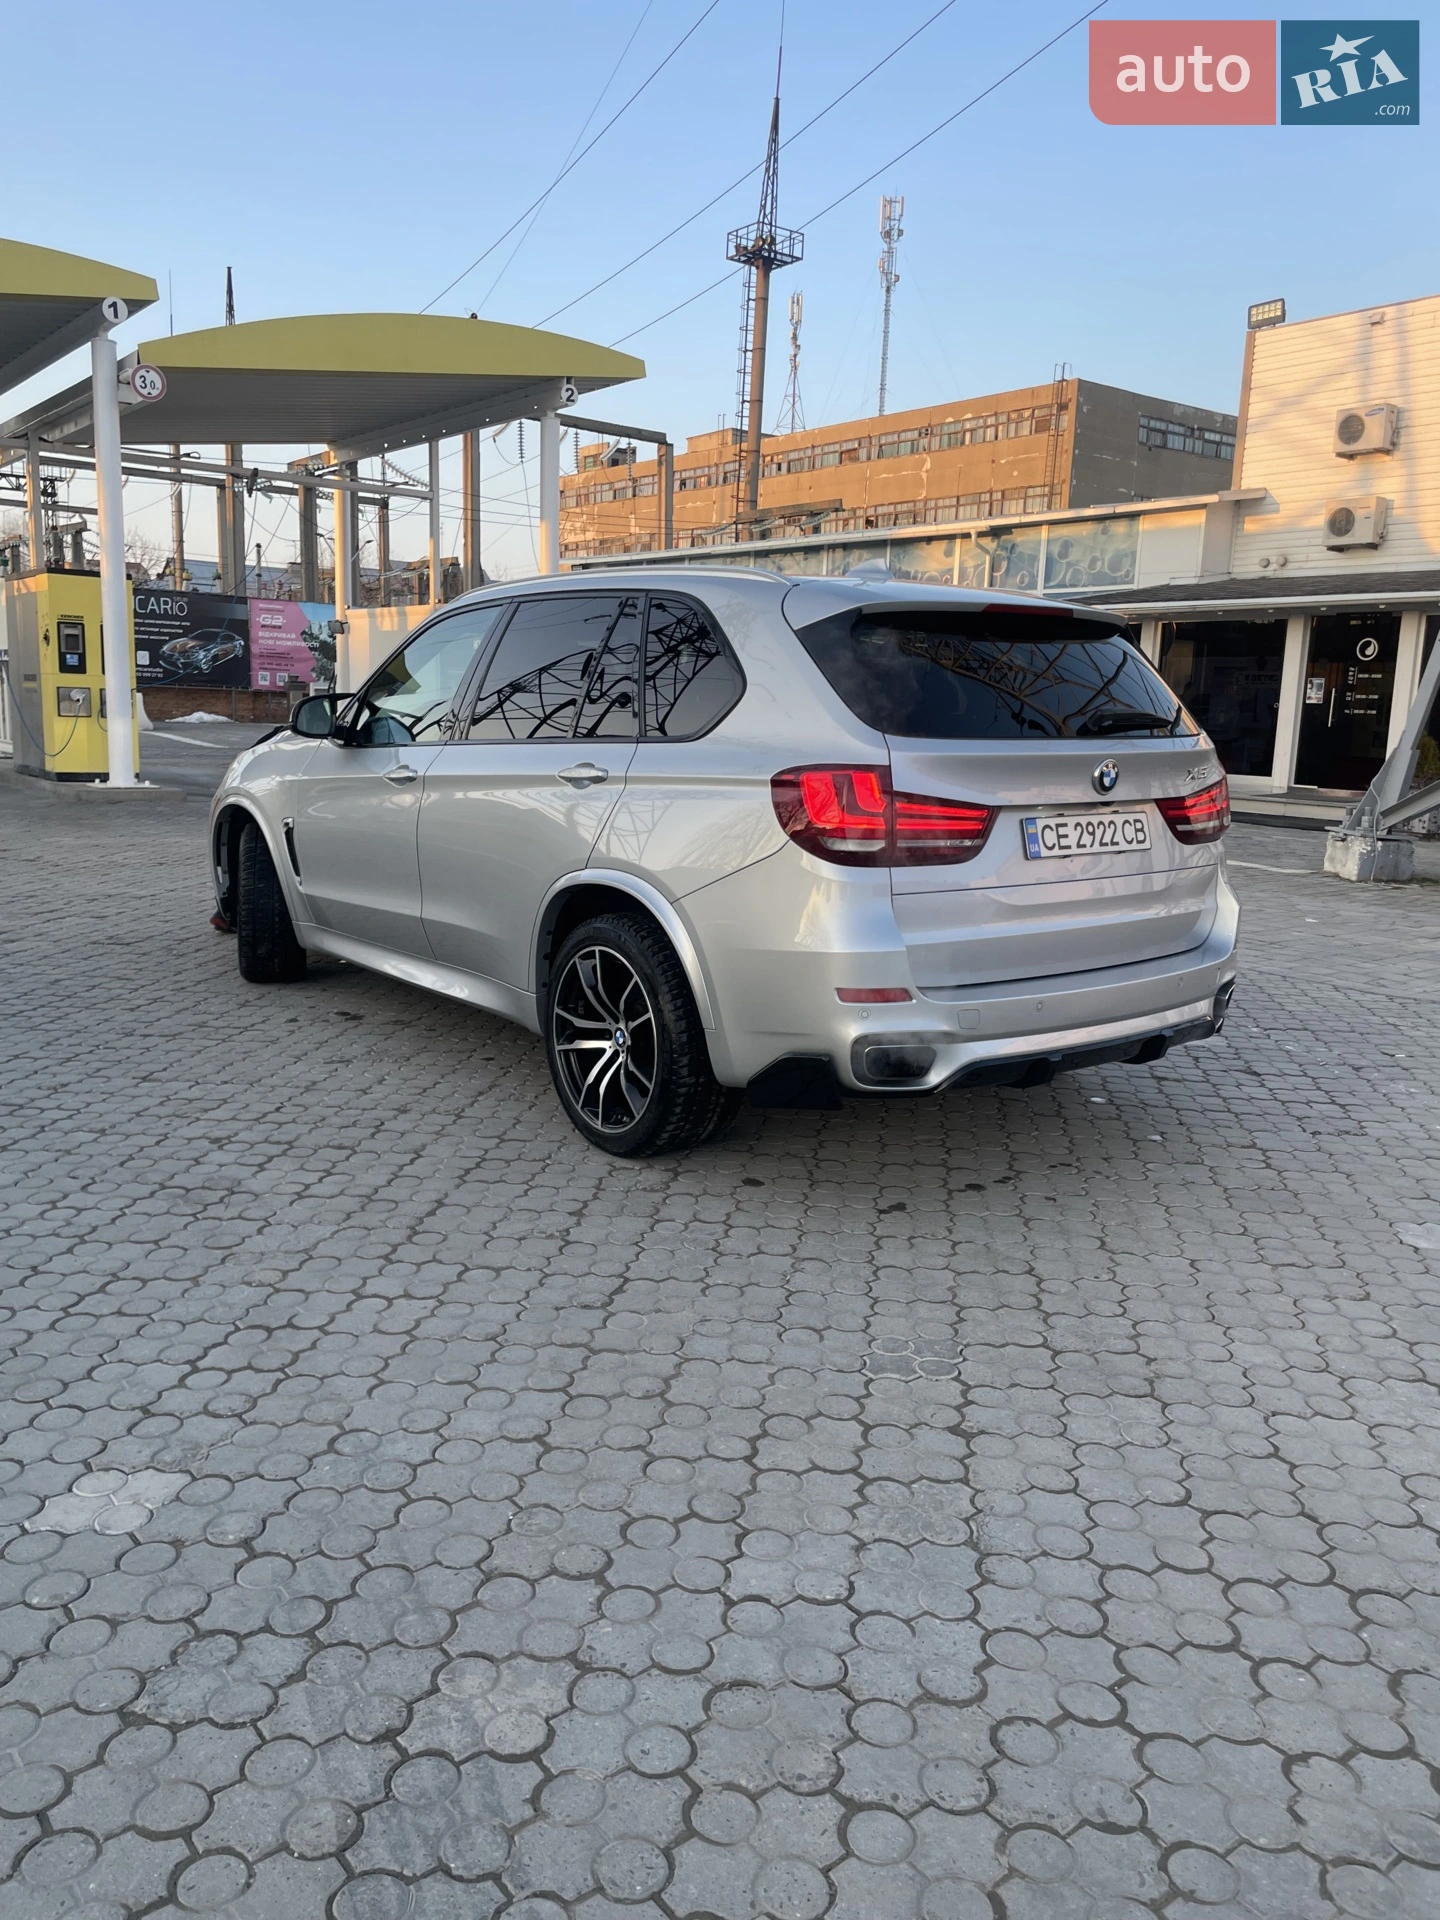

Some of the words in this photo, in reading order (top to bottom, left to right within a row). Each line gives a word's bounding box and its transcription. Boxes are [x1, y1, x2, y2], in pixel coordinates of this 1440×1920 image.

[107, 301, 119, 320] 1
[565, 387, 575, 402] 2
[276, 640, 320, 648] МОЖЛИВОСТІ
[1185, 766, 1208, 782] X5
[1029, 843, 1040, 854] UA
